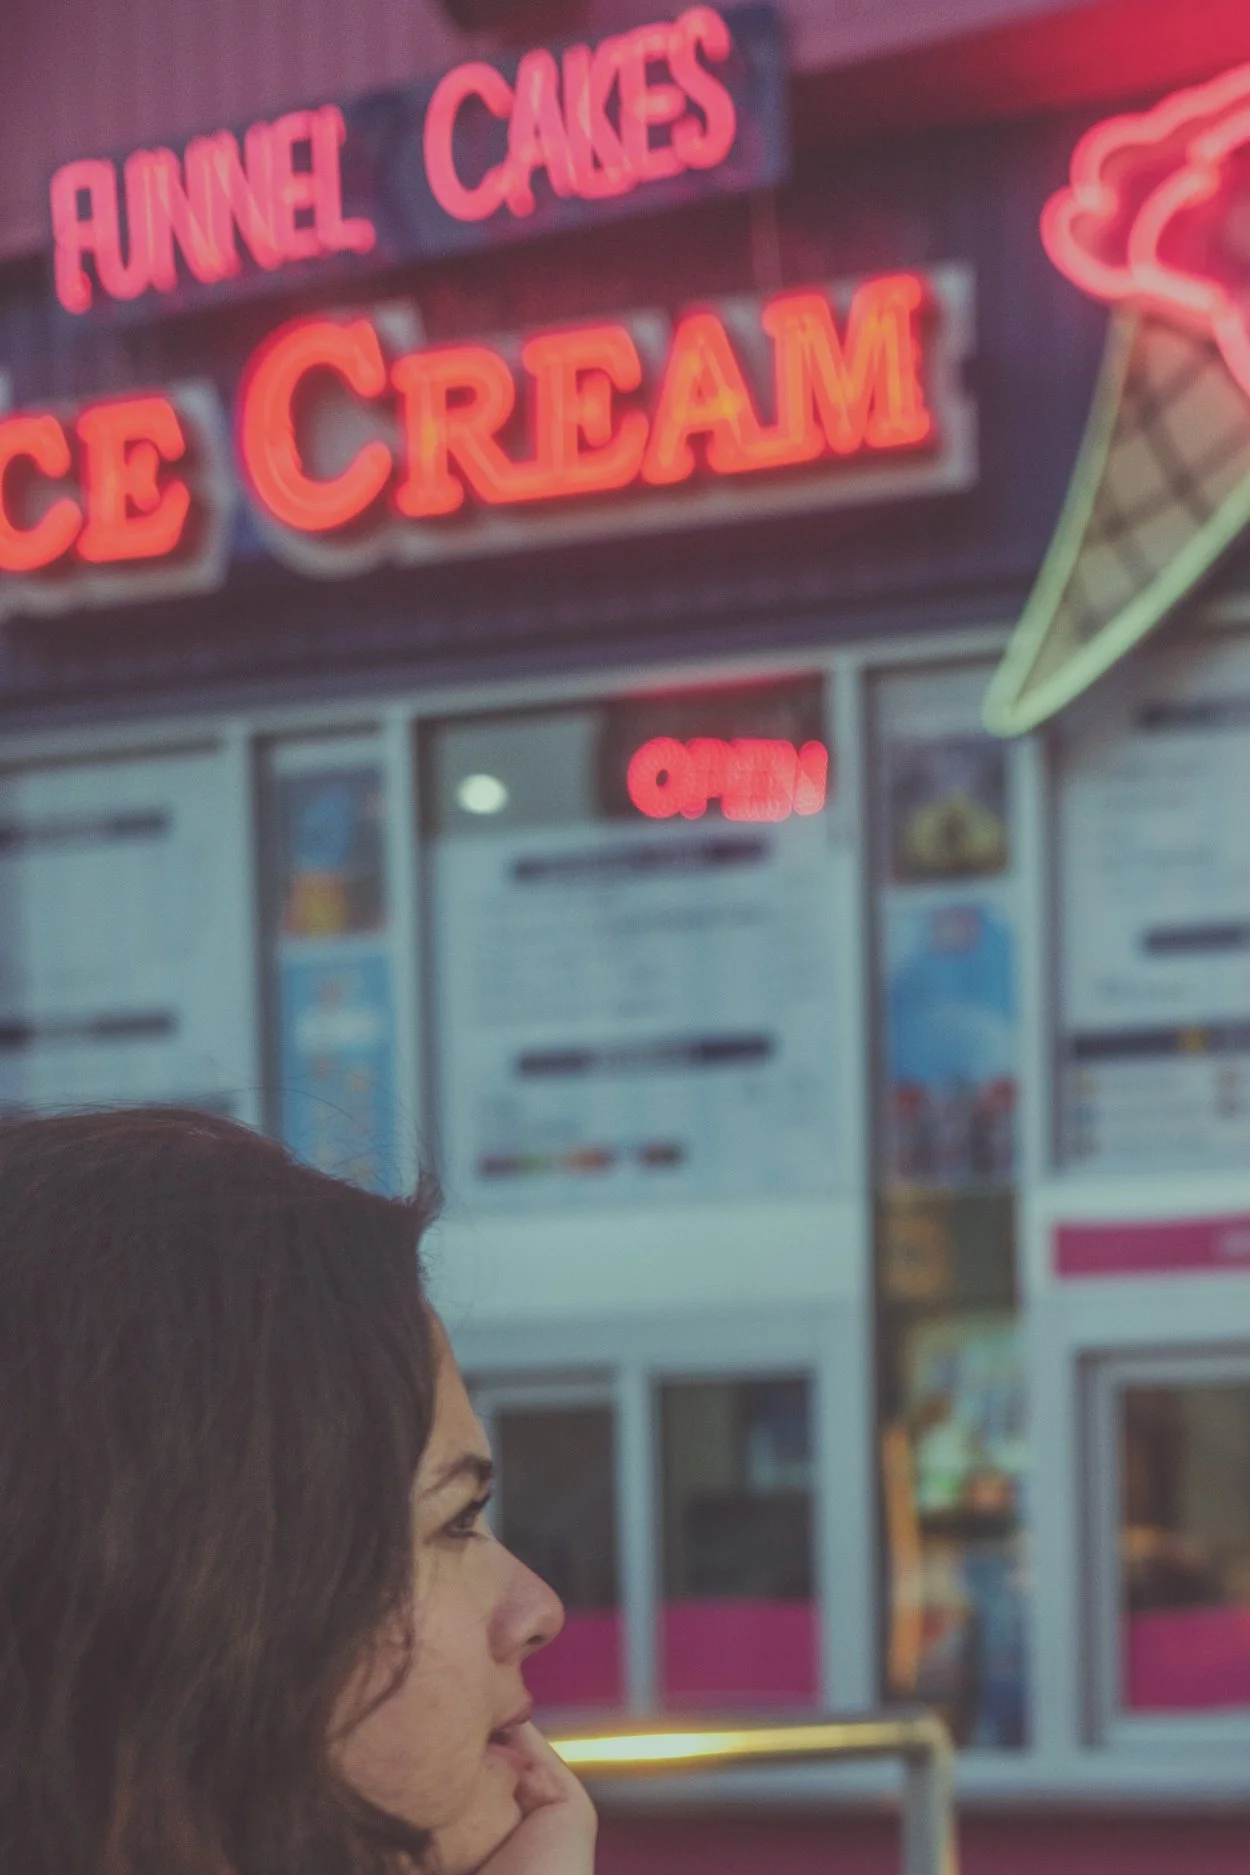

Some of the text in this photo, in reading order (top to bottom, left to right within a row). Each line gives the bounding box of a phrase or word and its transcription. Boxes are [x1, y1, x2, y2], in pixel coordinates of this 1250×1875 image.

[51, 7, 738, 313] FUNNEL CAKES
[242, 274, 933, 531] CREAM
[628, 737, 828, 821] OPEN
